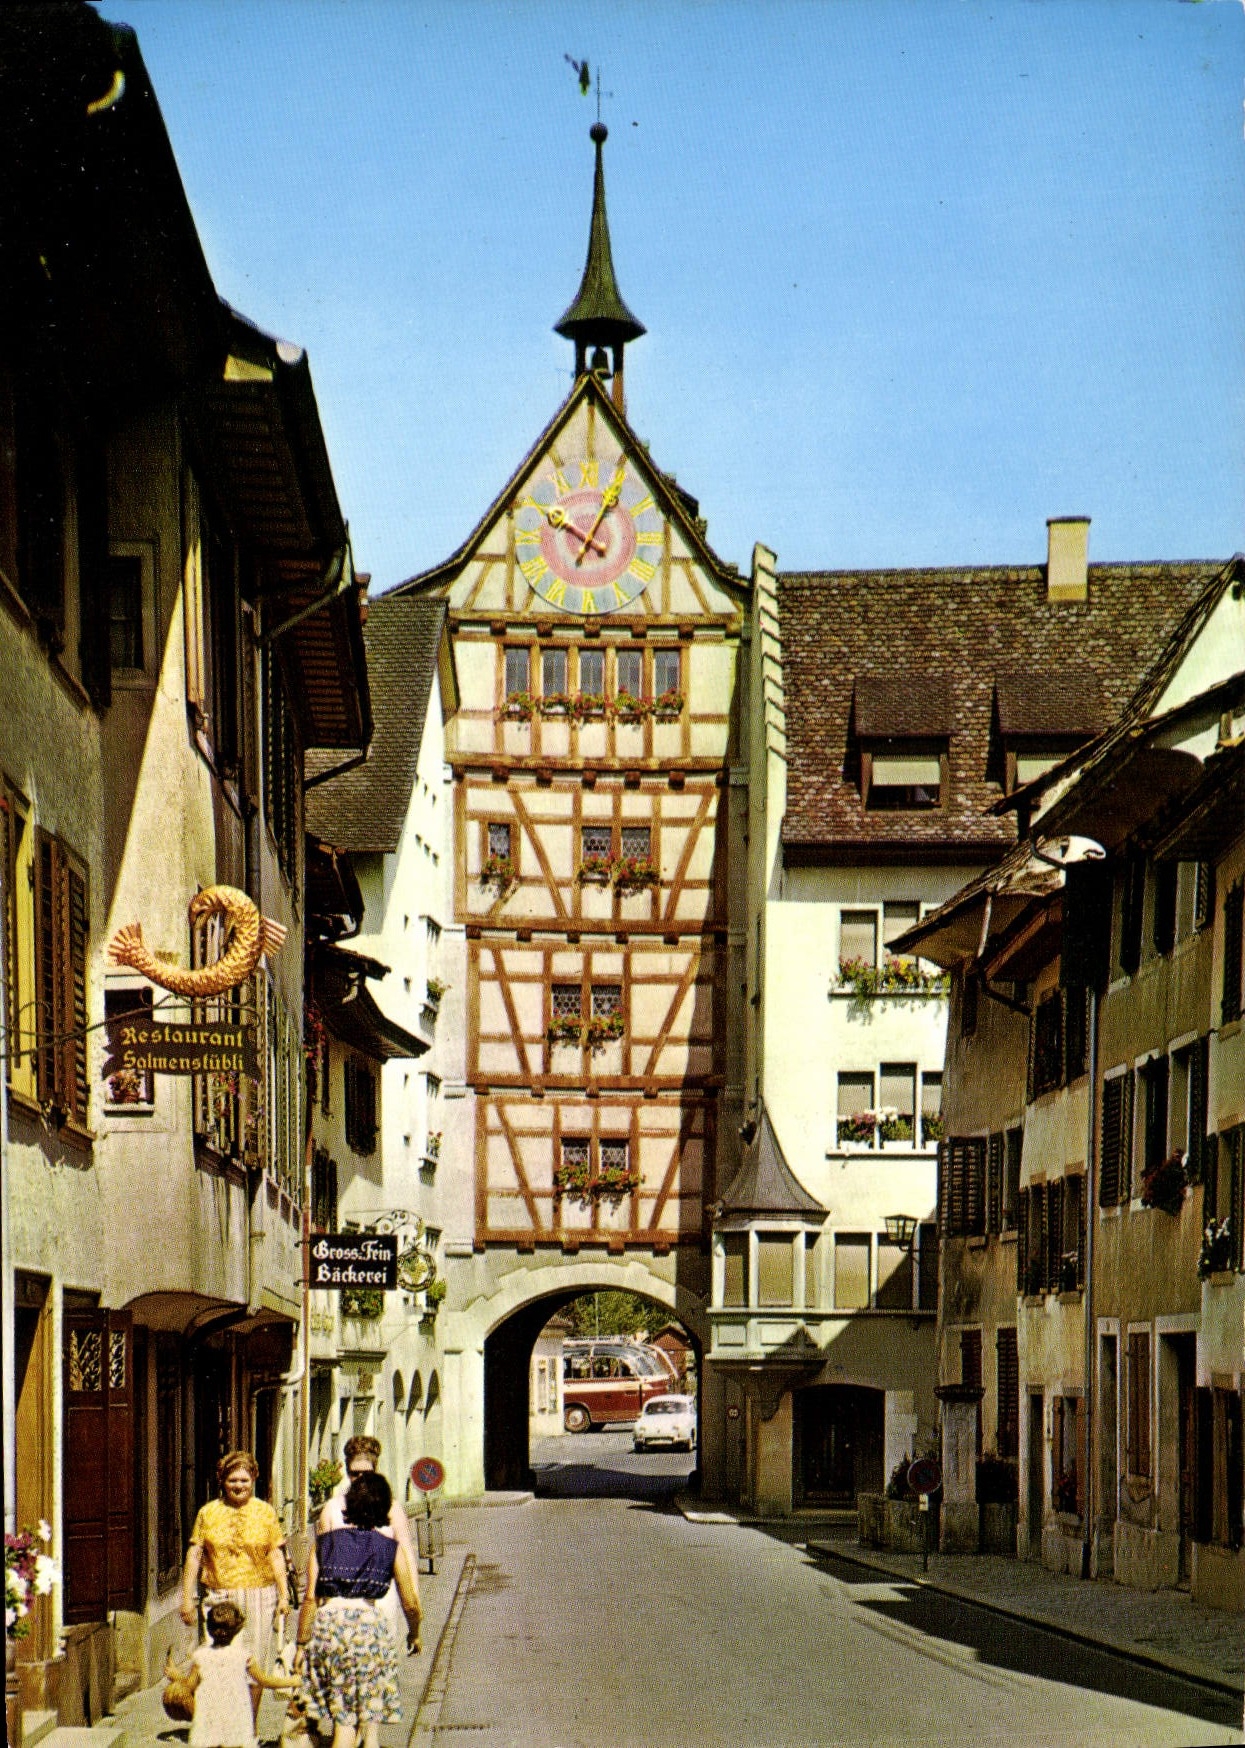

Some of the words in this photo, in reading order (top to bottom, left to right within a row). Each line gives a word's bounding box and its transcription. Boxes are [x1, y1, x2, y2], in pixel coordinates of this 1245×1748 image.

[120, 1026, 243, 1048] Restaurant
[122, 1050, 244, 1071] Salmenstübli
[315, 1262, 388, 1284] Bäckerei
